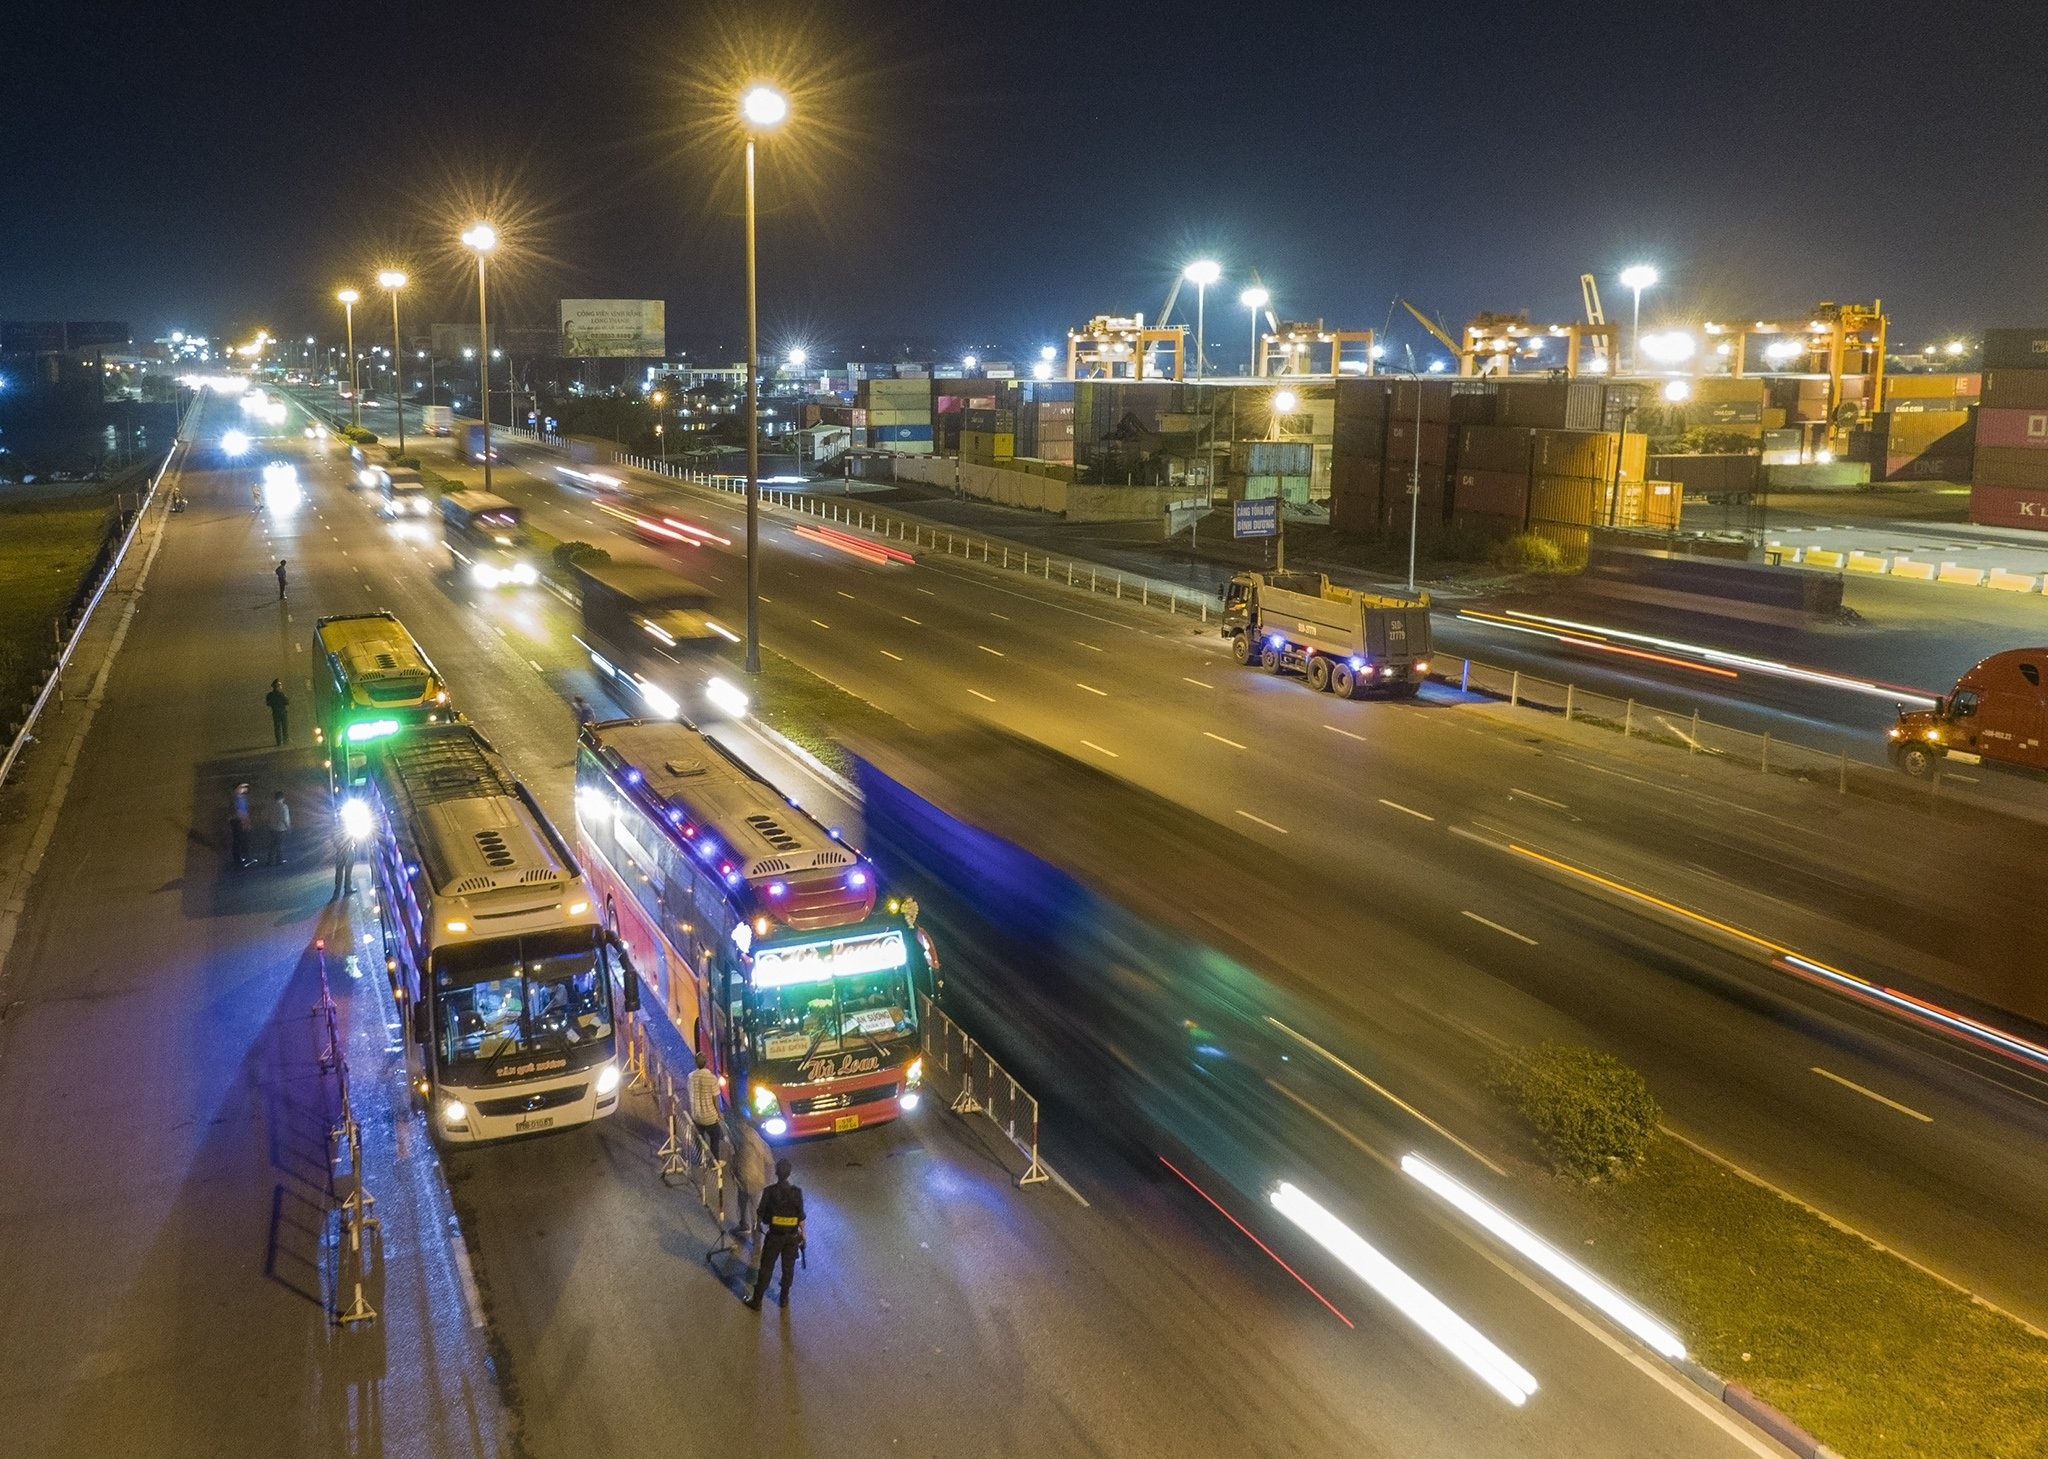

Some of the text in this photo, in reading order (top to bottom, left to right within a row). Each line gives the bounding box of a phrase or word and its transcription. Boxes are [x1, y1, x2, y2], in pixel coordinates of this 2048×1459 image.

[576, 309, 595, 317] CÔNG
[595, 309, 609, 317] VIÊN
[807, 1054, 880, 1081] Hà Loan
